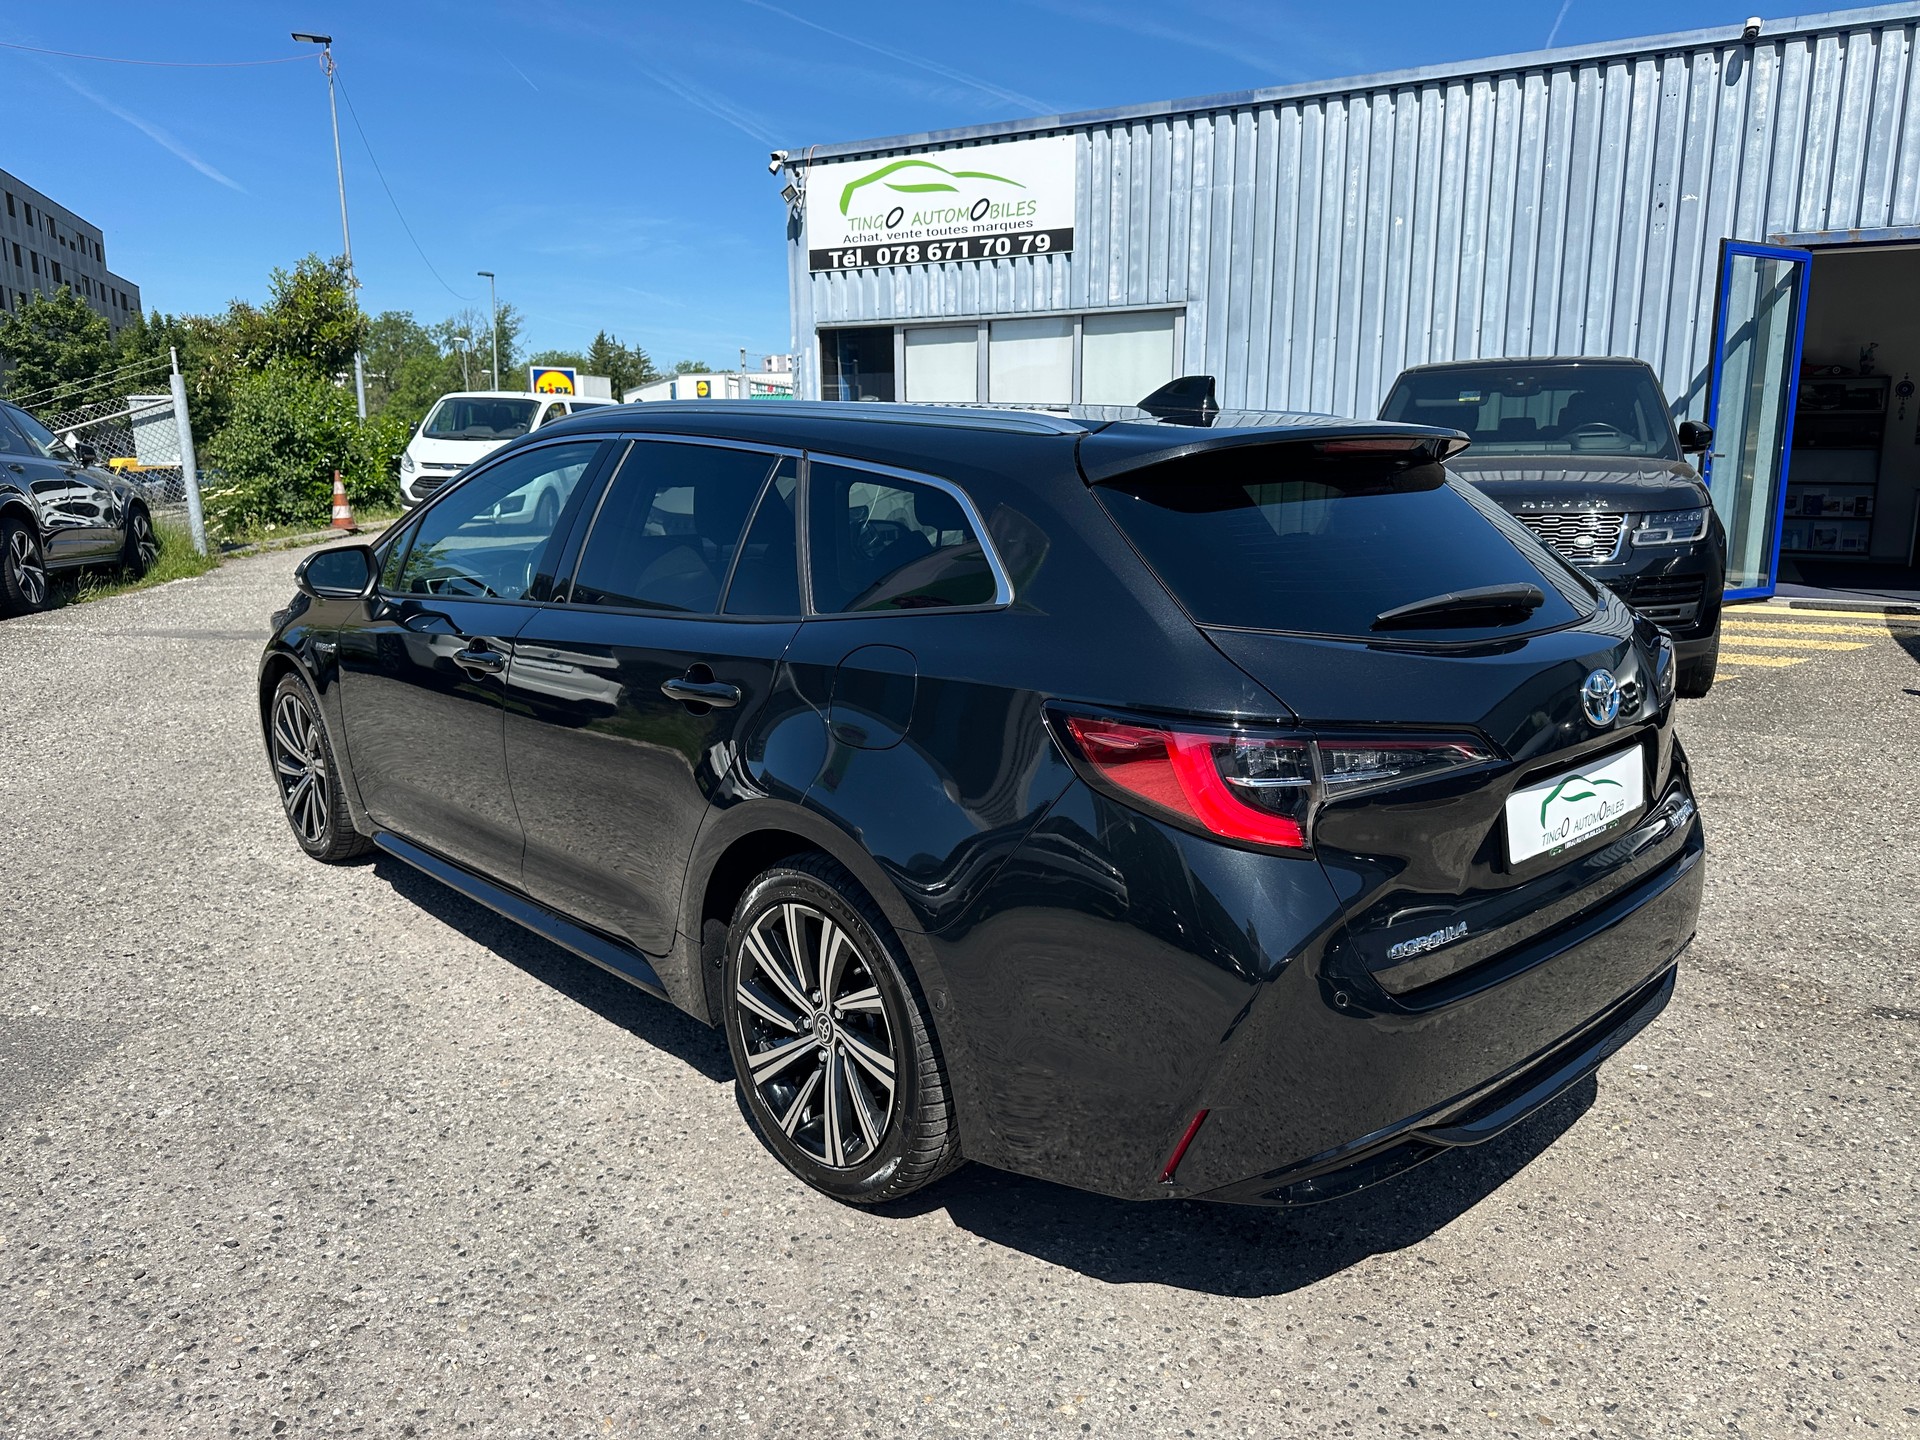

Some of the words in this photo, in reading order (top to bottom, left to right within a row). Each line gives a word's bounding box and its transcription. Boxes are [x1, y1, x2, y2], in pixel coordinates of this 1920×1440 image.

[848, 206, 904, 232] TINGO
[911, 198, 1037, 227] AUTOMOBILES
[843, 232, 883, 245] Achat,
[886, 230, 923, 241] vente
[926, 225, 969, 238] toutes
[972, 220, 1034, 234] marques
[828, 248, 870, 269] Tél.
[876, 245, 921, 266] 078
[927, 240, 970, 262] 671
[979, 237, 1012, 257] 70
[1018, 233, 1051, 253] 79
